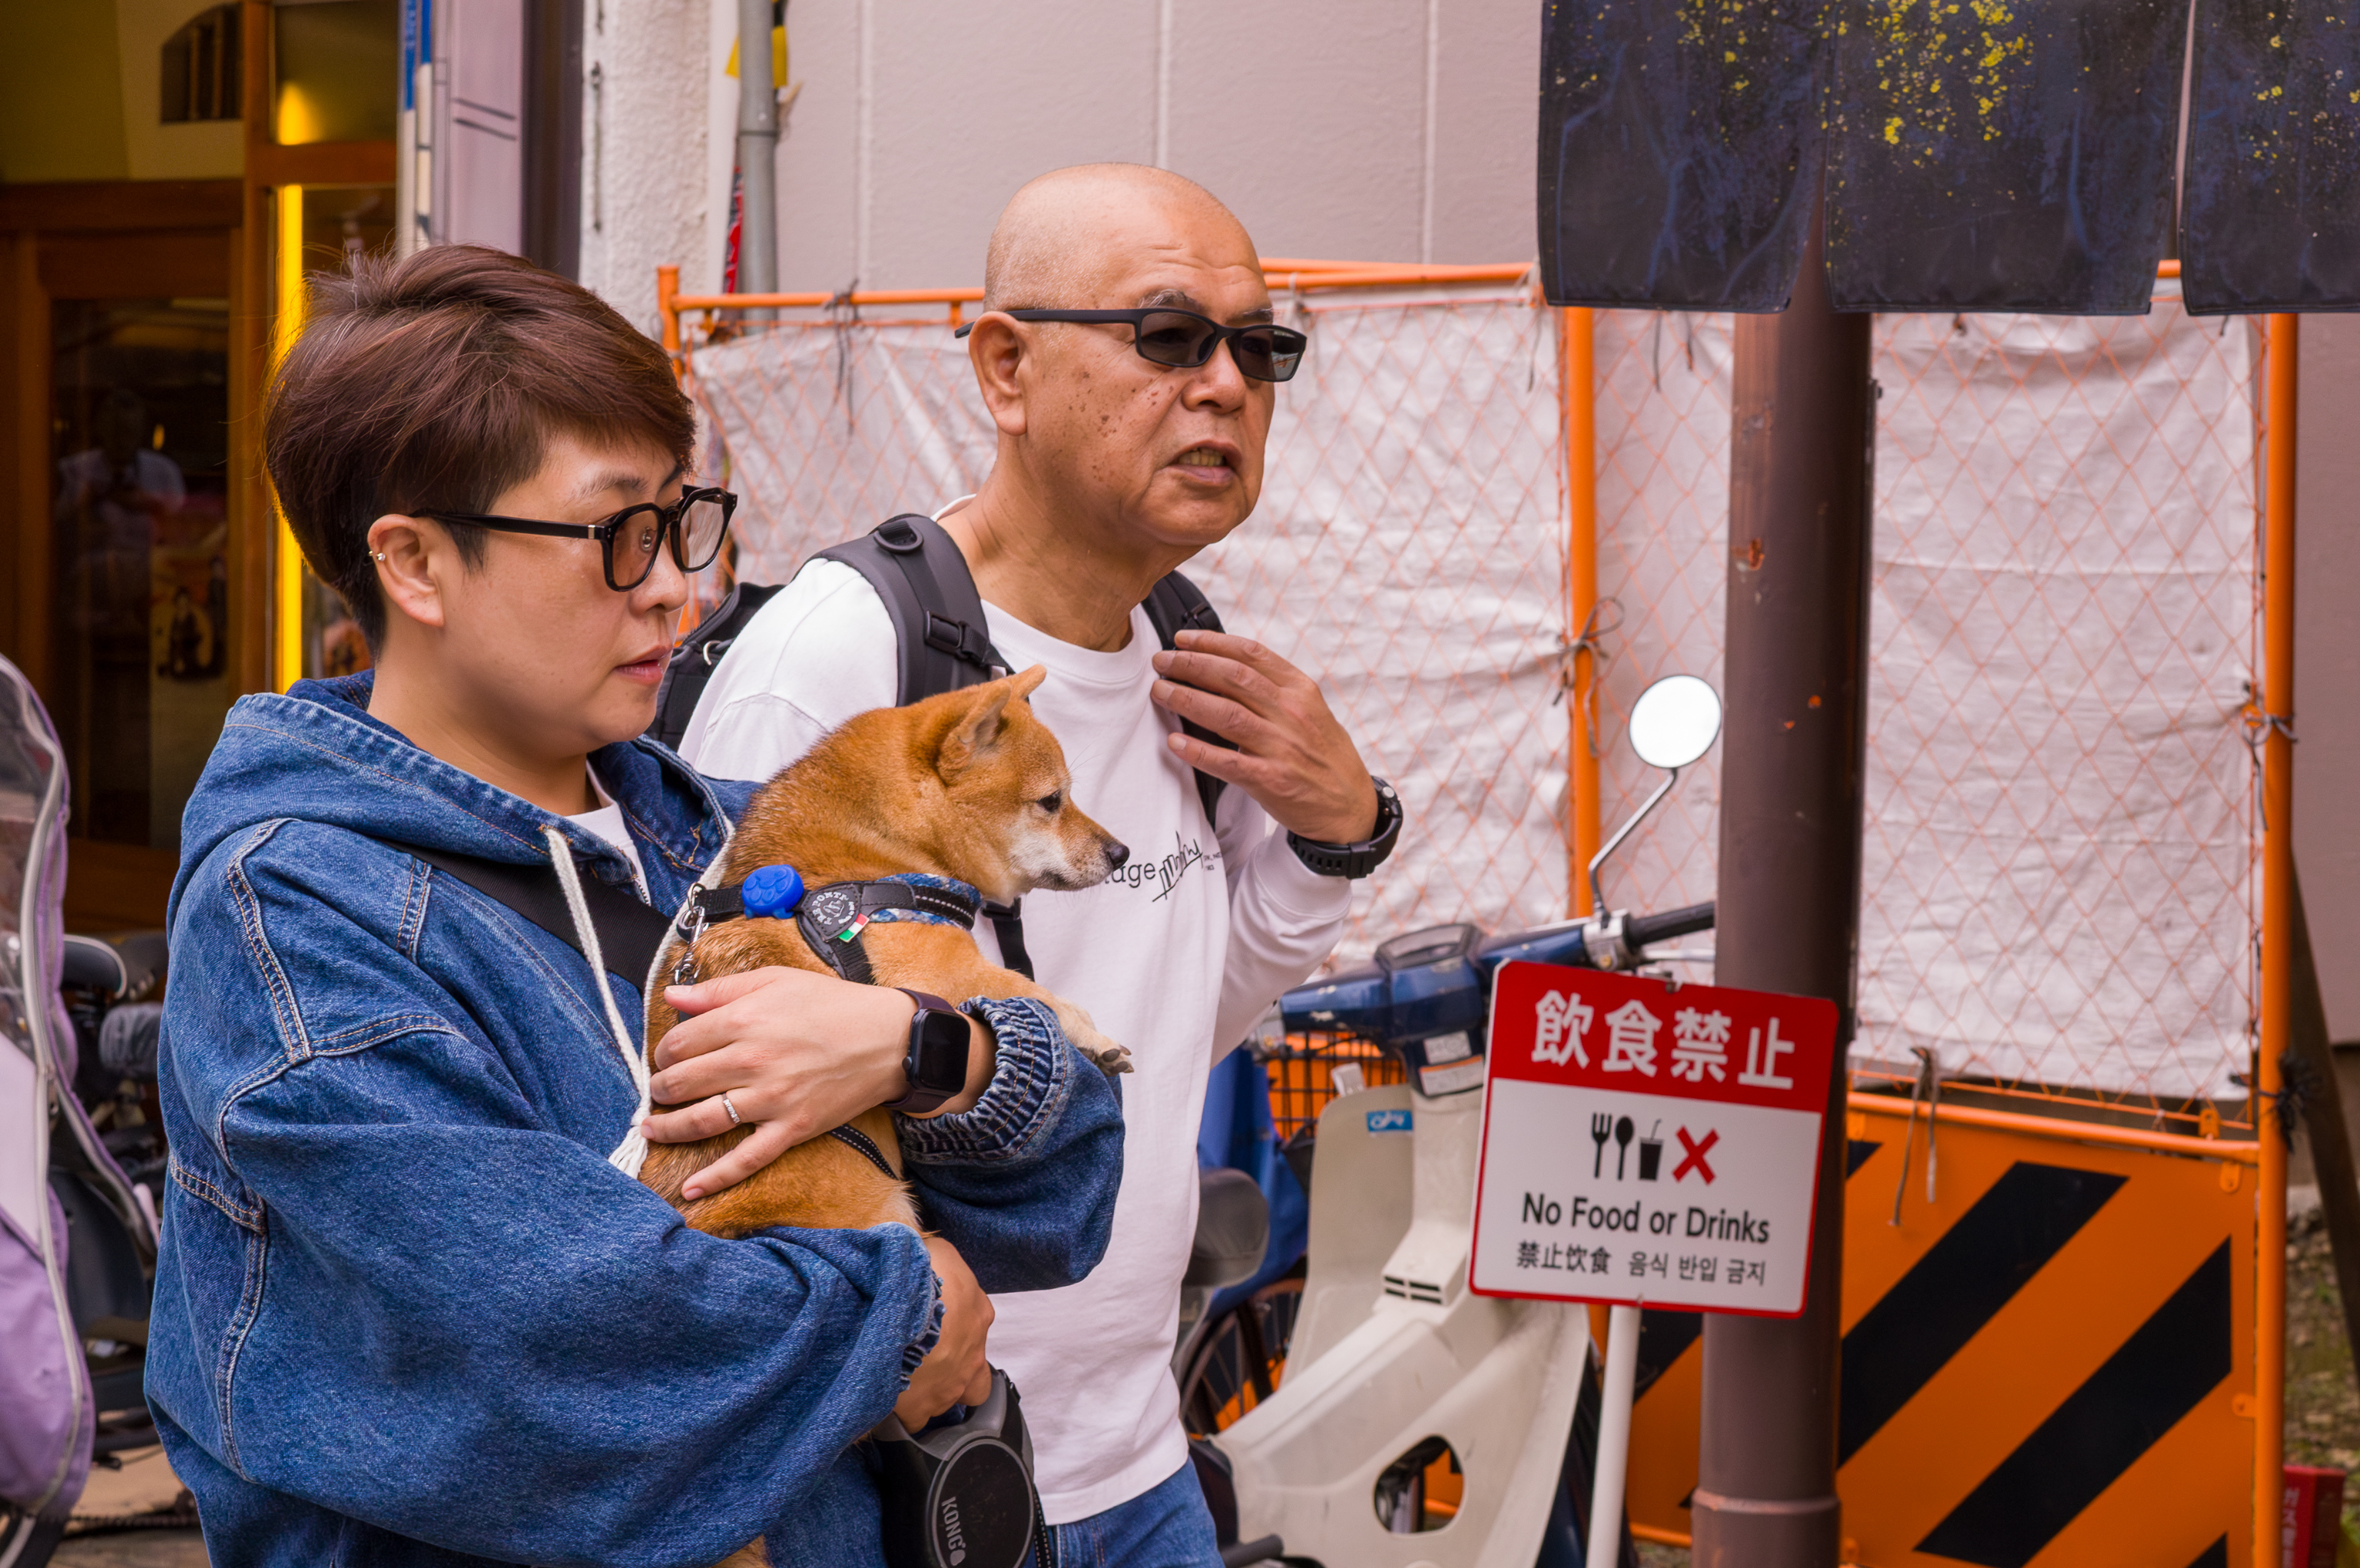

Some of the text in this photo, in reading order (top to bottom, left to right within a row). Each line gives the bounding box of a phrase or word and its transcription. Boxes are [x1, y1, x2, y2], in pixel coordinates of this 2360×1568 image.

[1531, 990, 1795, 1090] 飲食禁止
[1522, 1192, 1771, 1245] No Food or Drinks
[1516, 1240, 1613, 1275] 禁止饮食
[1629, 1251, 1766, 1287] 음식 반입 금지
[941, 1497, 963, 1550] KONG
